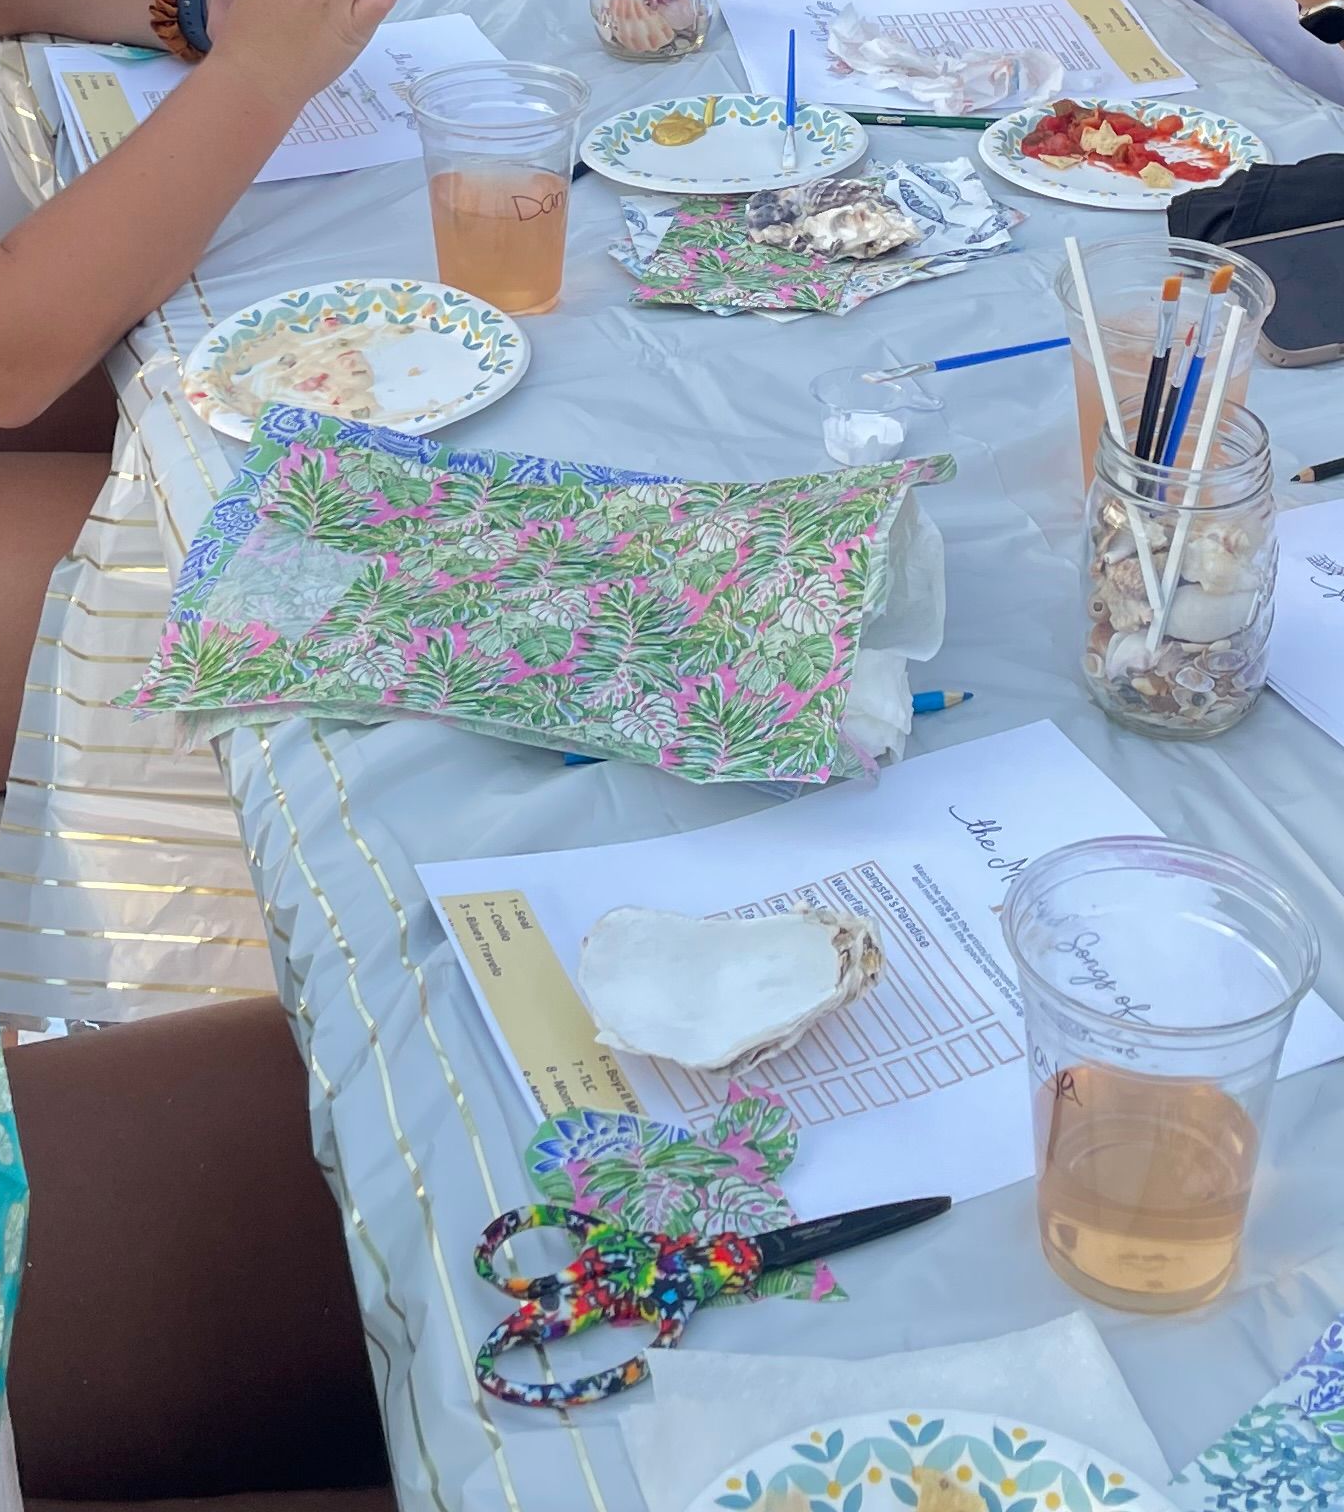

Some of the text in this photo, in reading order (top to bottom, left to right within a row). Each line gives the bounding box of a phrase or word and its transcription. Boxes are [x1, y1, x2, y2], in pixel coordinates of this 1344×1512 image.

[511, 191, 564, 221] Dan
[514, 909, 534, 930] Seal
[860, 866, 930, 949] Gangsta's Paradise
[948, 805, 1003, 852] the
[1057, 932, 1117, 992] Songs
[1108, 996, 1151, 1026] of
[466, 916, 484, 941] Blues
[491, 913, 511, 941] Coolio
[579, 1074, 598, 1093] TLC
[606, 1068, 626, 1094] Boyz
[554, 1080, 577, 1112] Monte
